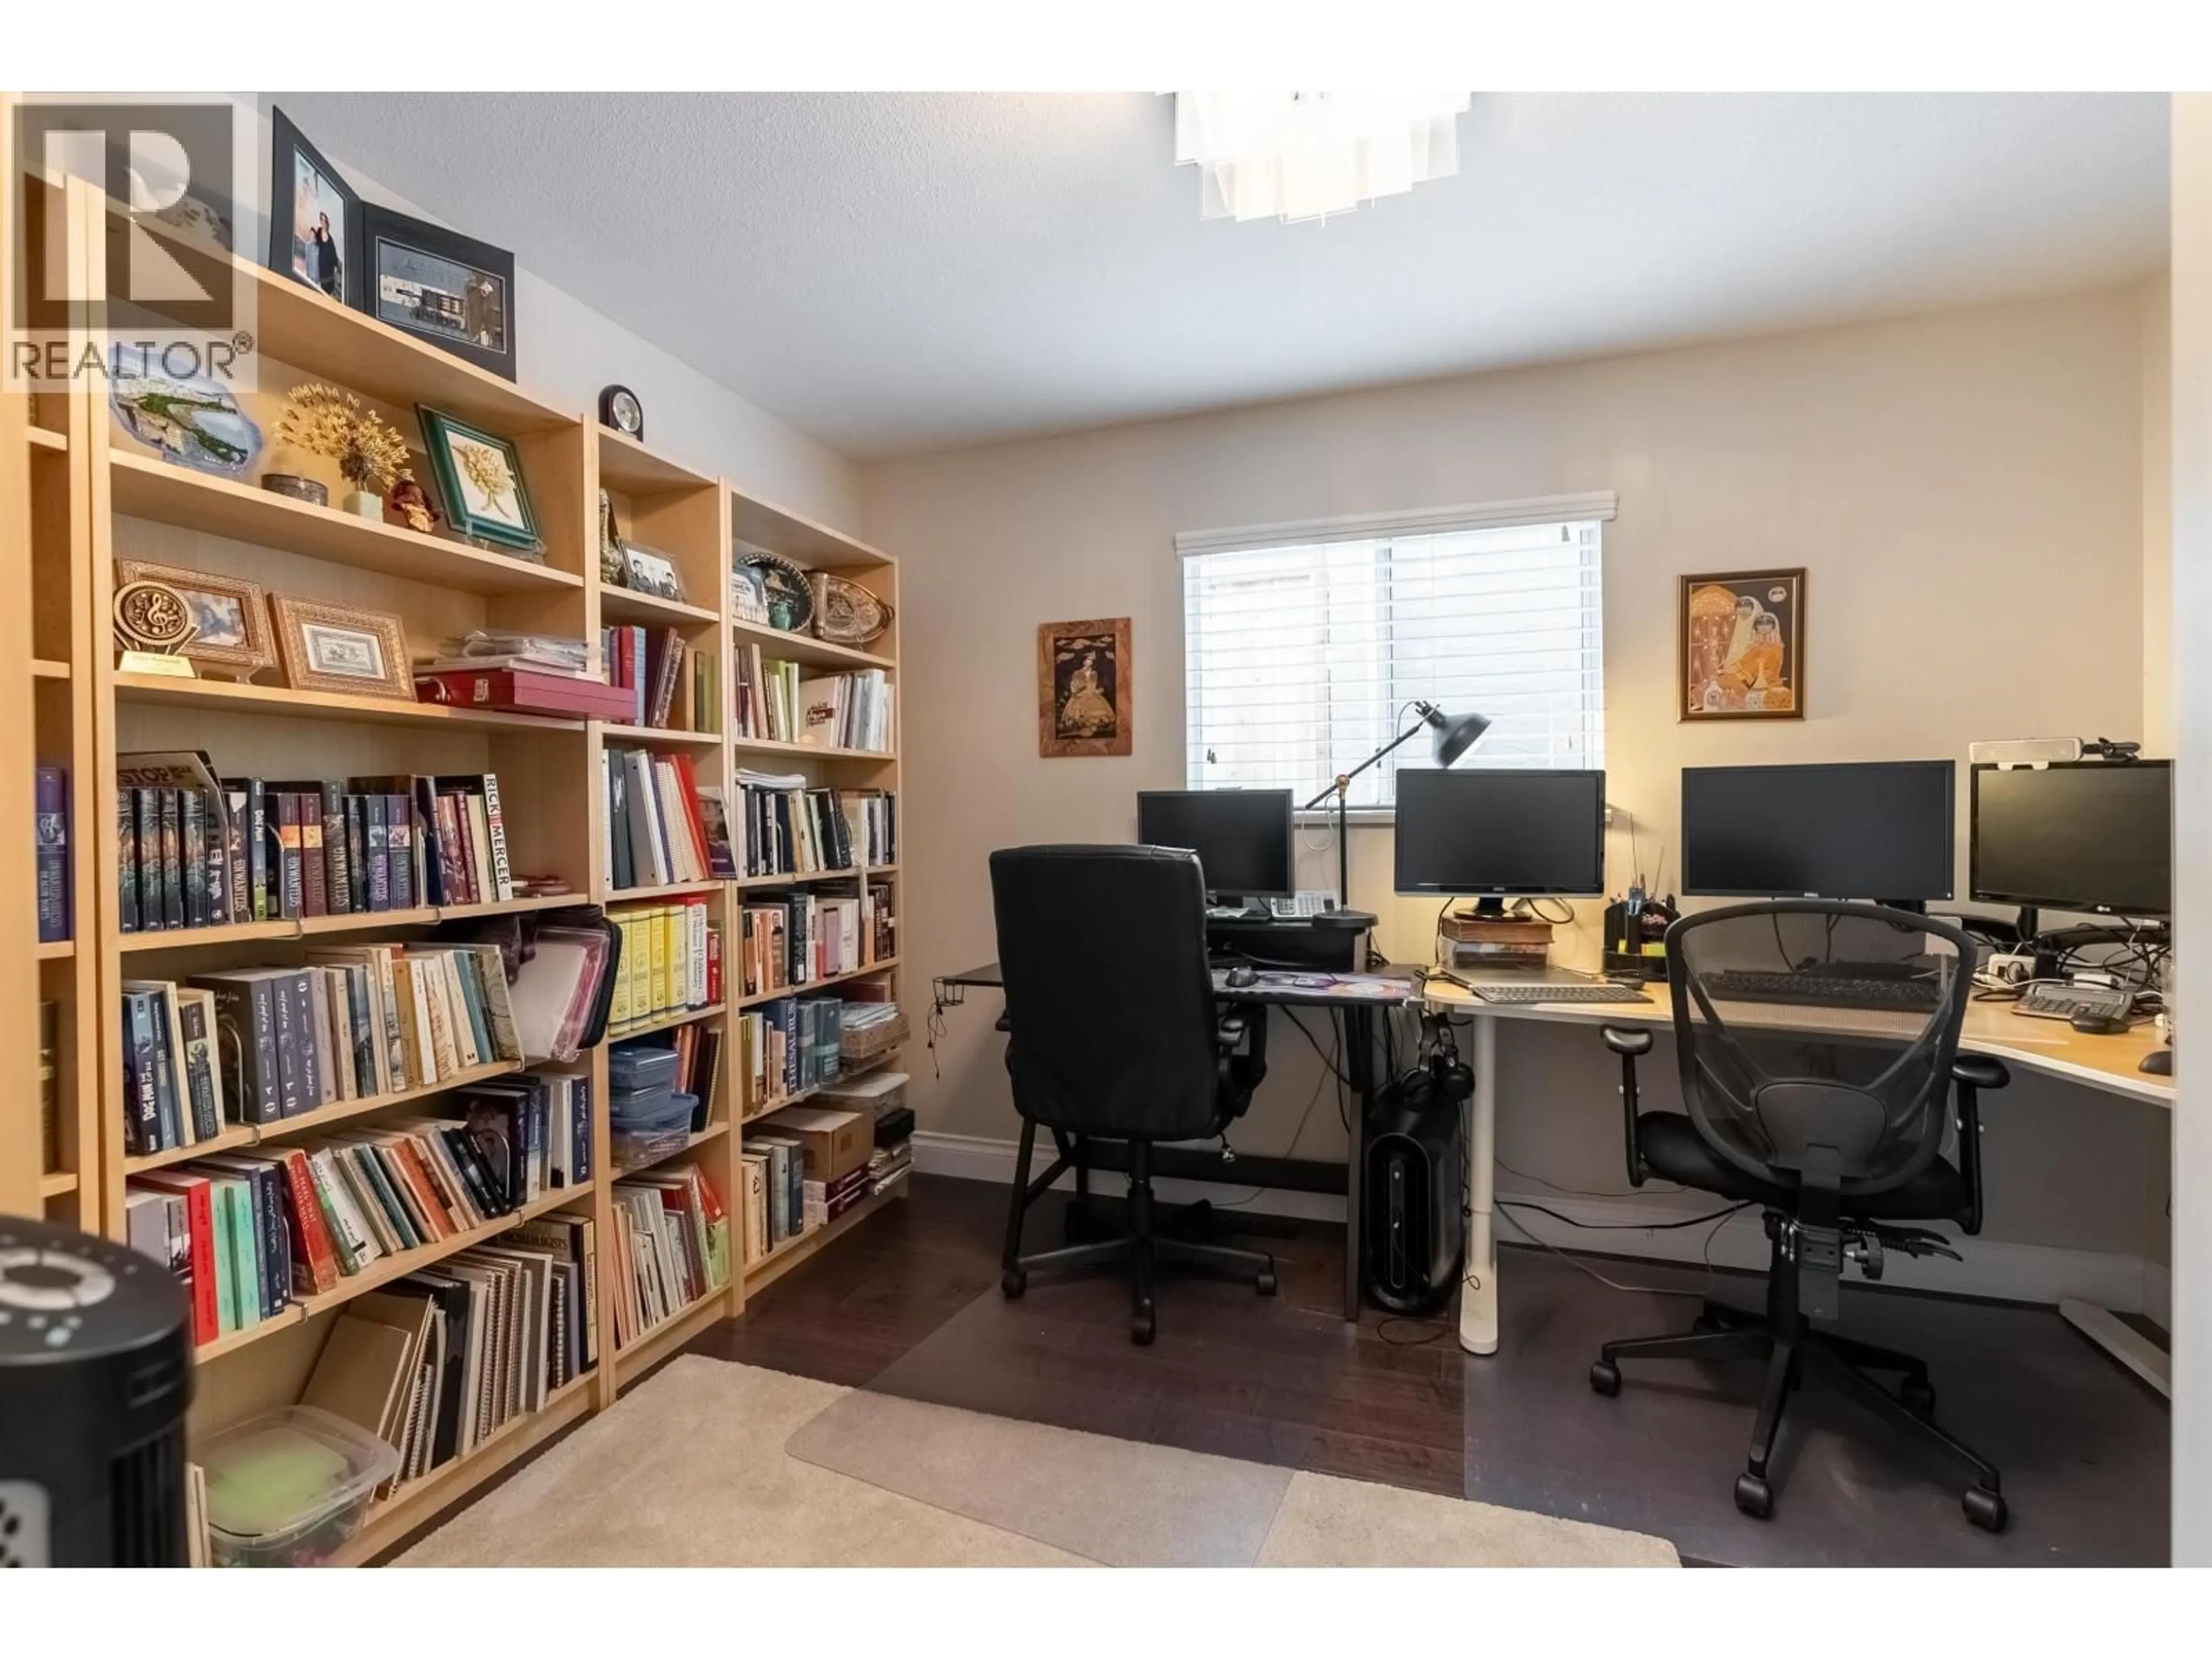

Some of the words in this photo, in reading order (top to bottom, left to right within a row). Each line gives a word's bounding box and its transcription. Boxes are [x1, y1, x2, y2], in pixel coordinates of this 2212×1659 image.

[486, 778, 501, 815] RICK
[493, 825, 509, 885] MERCER
[787, 1002, 797, 1093] THESAURUS
[305, 1202, 316, 1222] THAT
